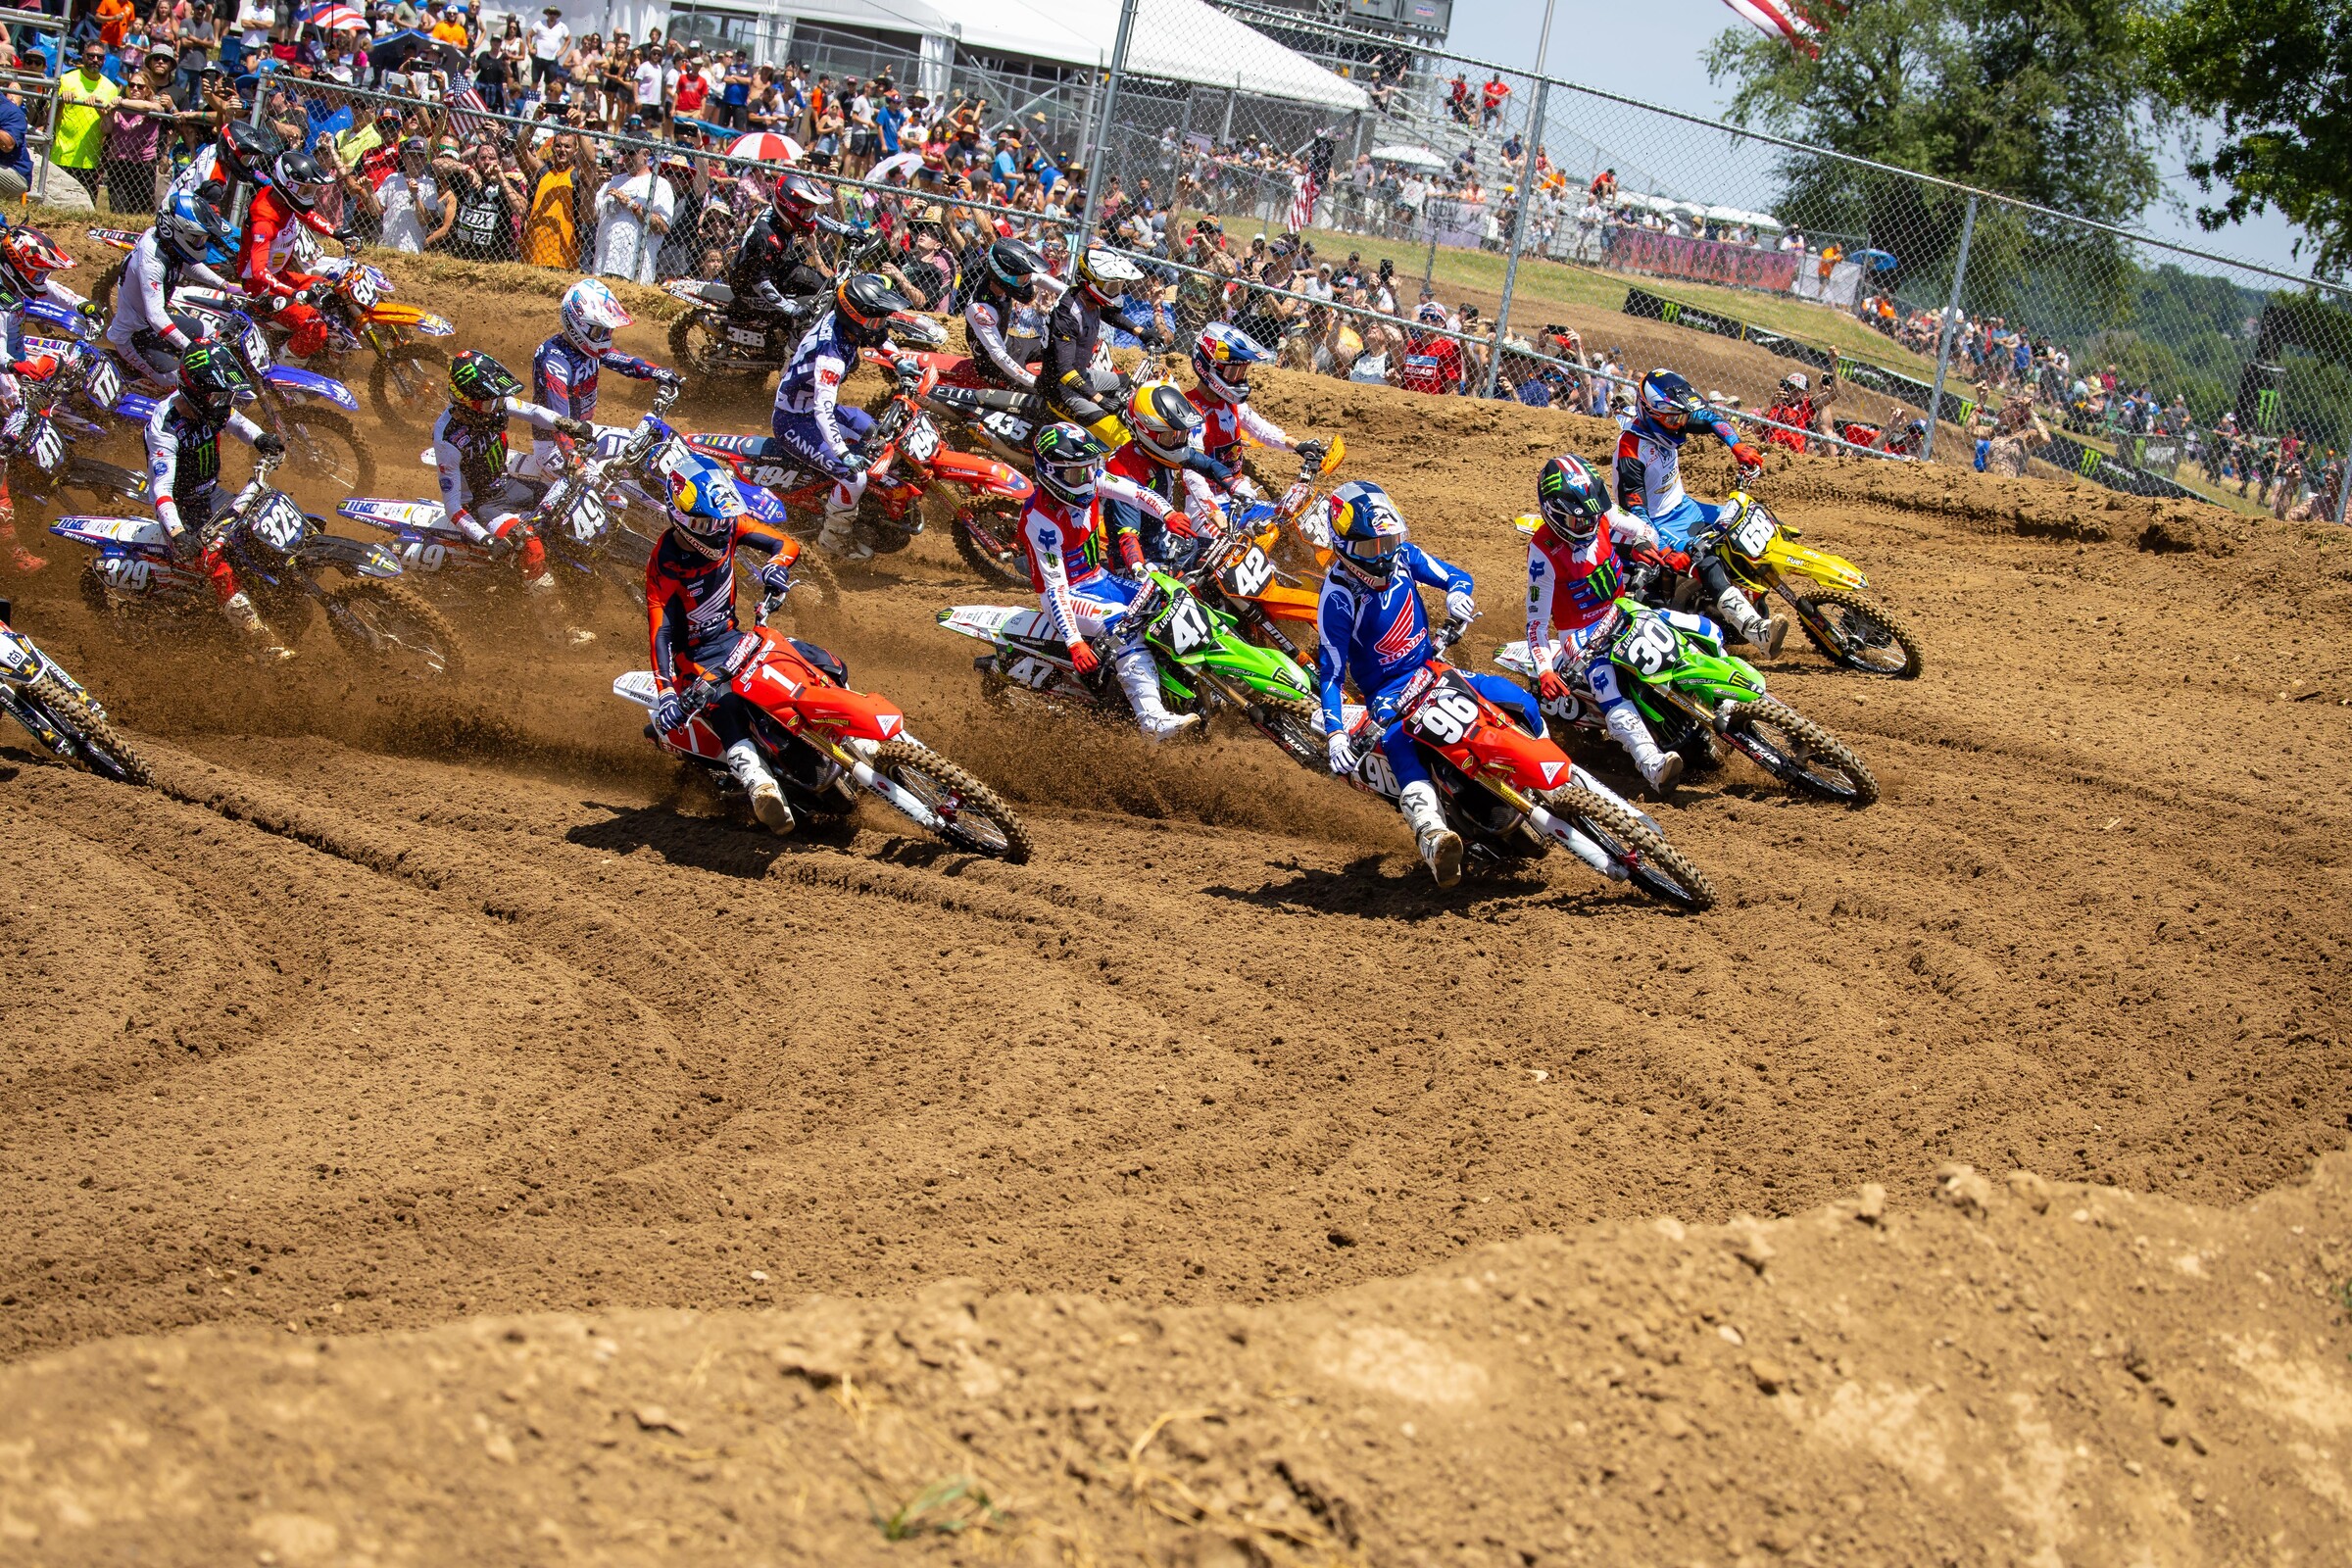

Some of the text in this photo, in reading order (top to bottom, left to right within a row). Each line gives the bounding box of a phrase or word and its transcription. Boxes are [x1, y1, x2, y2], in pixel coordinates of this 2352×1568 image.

[822, 399, 842, 445] CANVAS
[984, 410, 1033, 441] 435
[784, 428, 835, 472] CANVAS
[753, 465, 799, 488] 194
[354, 514, 391, 529] DUNLOP
[571, 489, 607, 540] 49
[63, 530, 97, 545] DUNLOP
[1739, 508, 1776, 558] 68
[104, 558, 150, 589] 329
[401, 542, 447, 572] 49
[1234, 546, 1272, 597] 42
[1158, 608, 1176, 629] LUCAS
[1171, 590, 1207, 656] 47
[724, 631, 755, 668] RENTHAL
[1379, 626, 1428, 666] HONDA
[1622, 629, 1639, 650] LUCAS
[1628, 617, 1677, 675] 30
[761, 664, 796, 693] 1
[1007, 656, 1054, 689] 47
[1396, 669, 1429, 708] RENTHAL
[628, 691, 653, 704] DUNLOP
[1540, 693, 1580, 720] 30
[1422, 688, 1479, 745] 96
[1463, 721, 1478, 738] HONDA
[1364, 754, 1401, 796] 96
[866, 783, 914, 818] DUNLOP
